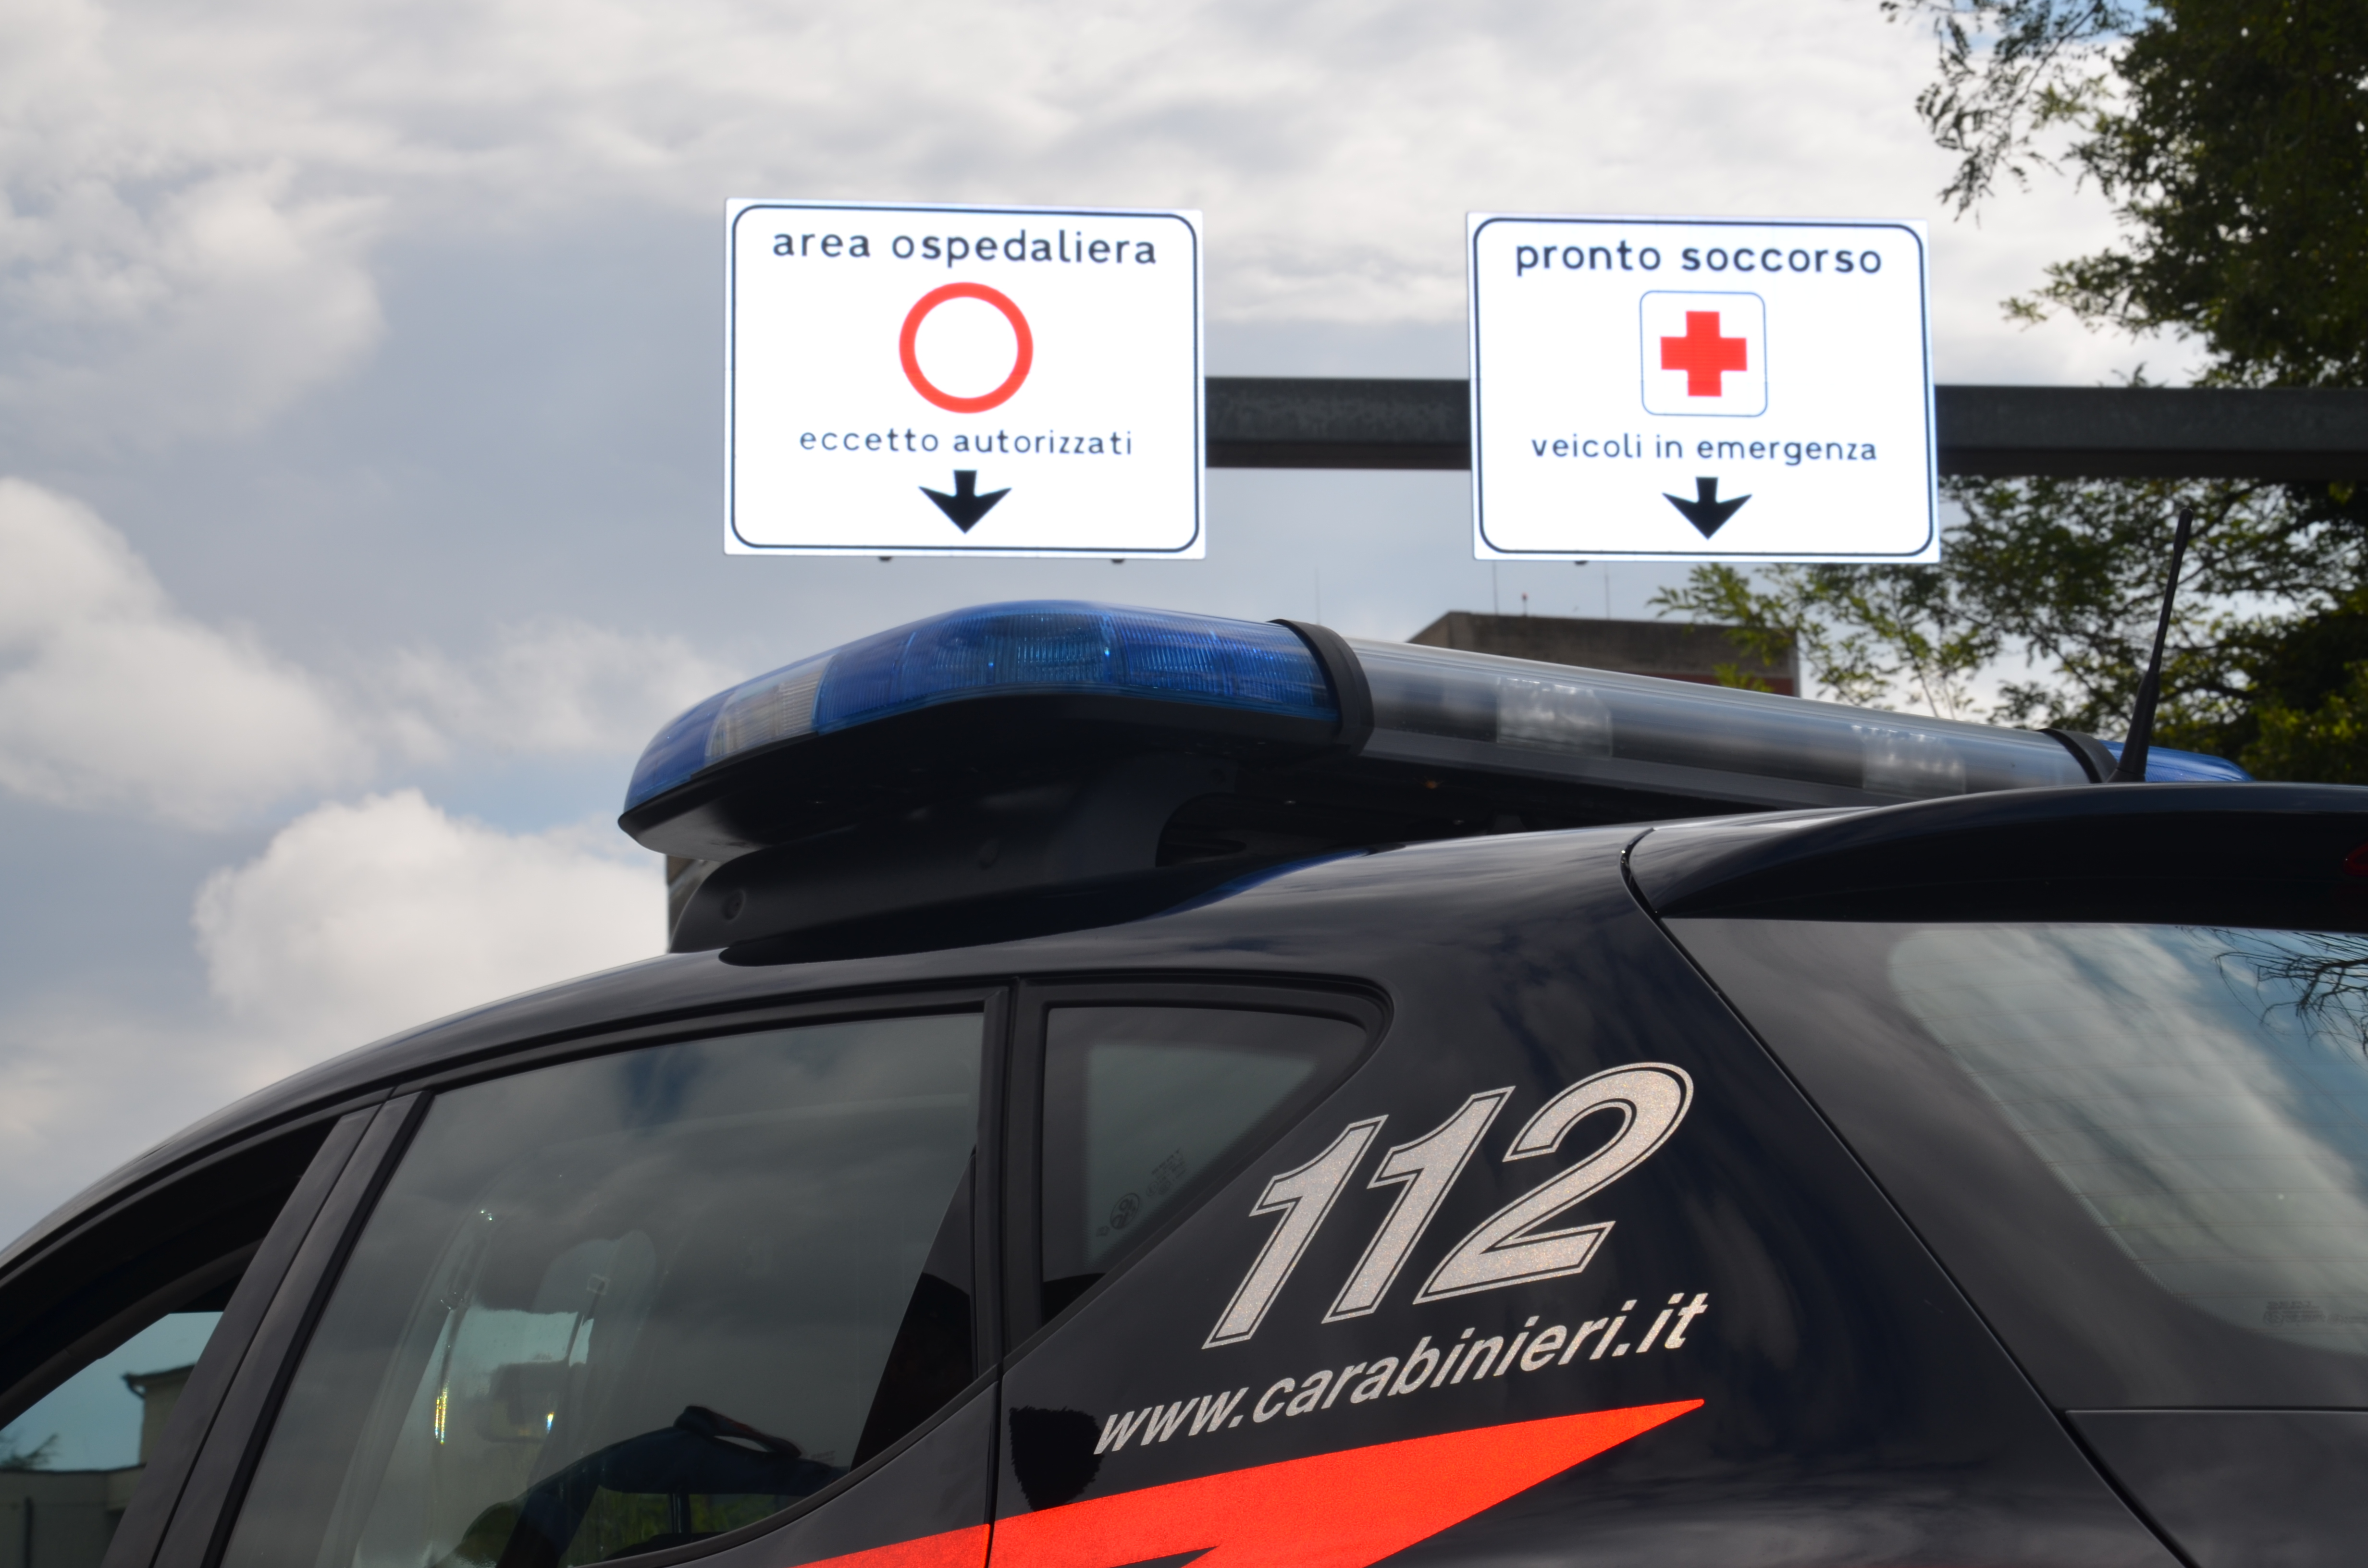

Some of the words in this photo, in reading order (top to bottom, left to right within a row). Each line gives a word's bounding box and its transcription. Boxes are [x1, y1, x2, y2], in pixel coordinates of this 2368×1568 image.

[772, 233, 871, 258] area
[891, 228, 1157, 269] ospedaliera
[1516, 239, 1662, 278] pronto
[1681, 247, 1883, 275] soccorso
[799, 428, 939, 453] eccetto
[952, 429, 1132, 456] autorizzati
[1530, 432, 1642, 459] veicoli
[1655, 434, 1683, 459] in
[1696, 439, 1877, 467] emergenza
[1201, 1062, 1694, 1349] 112
[1093, 1293, 1708, 1456] www.carabinieri.it
